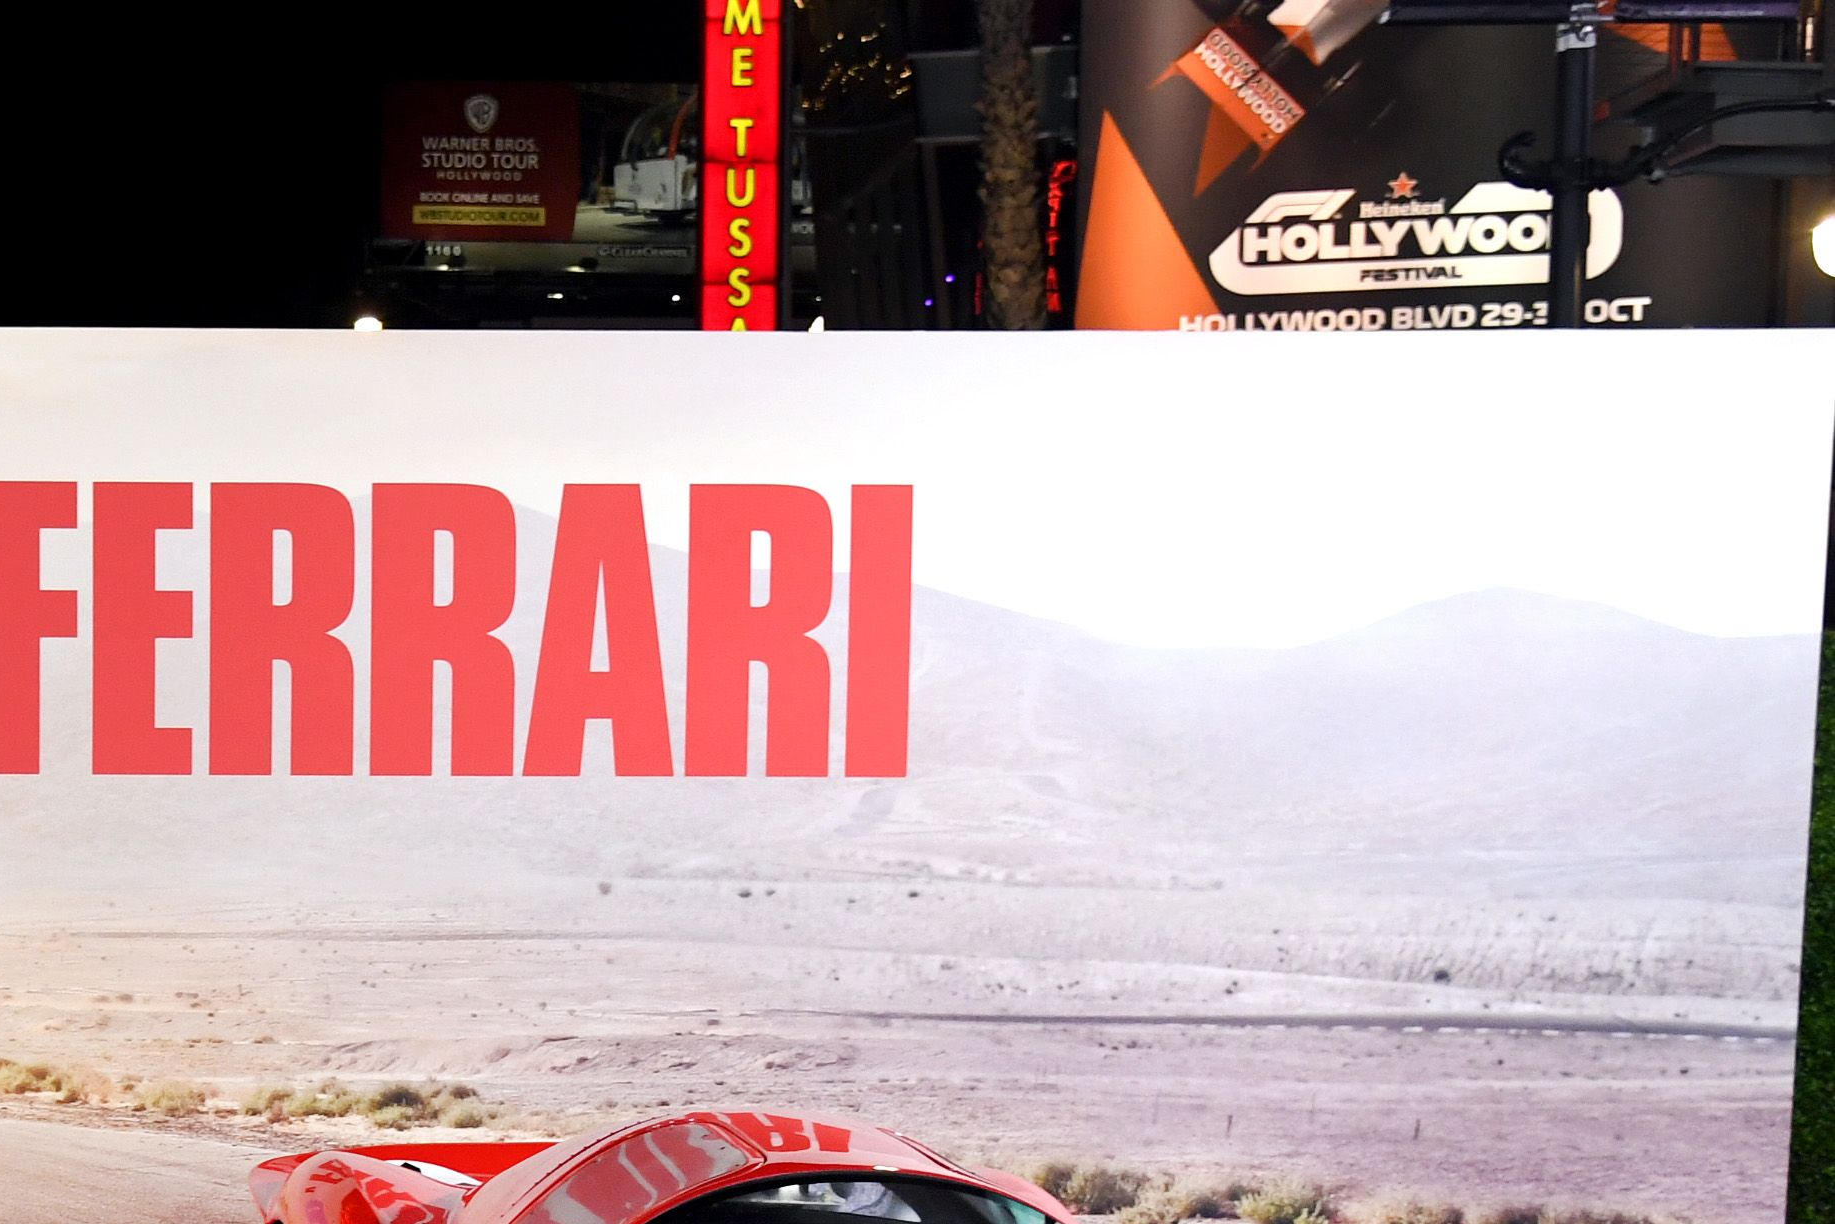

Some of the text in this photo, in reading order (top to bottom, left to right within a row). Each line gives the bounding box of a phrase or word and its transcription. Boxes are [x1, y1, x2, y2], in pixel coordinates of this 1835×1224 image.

[1193, 40, 1287, 134] HOLLYWOOD
[421, 136, 540, 152] WARNER BROS.
[421, 153, 540, 169] STUDIO TOUR
[436, 170, 523, 182] HOLLYWOOD
[419, 192, 540, 204] BOOK ONLINE AND SAVE
[1359, 198, 1444, 219] Heineken
[1242, 213, 1552, 263] HOLLYWOO
[1360, 266, 1463, 283] FESTIVAL
[1179, 296, 1652, 331] HOLLYWOOD BLVD 29-3 OCT
